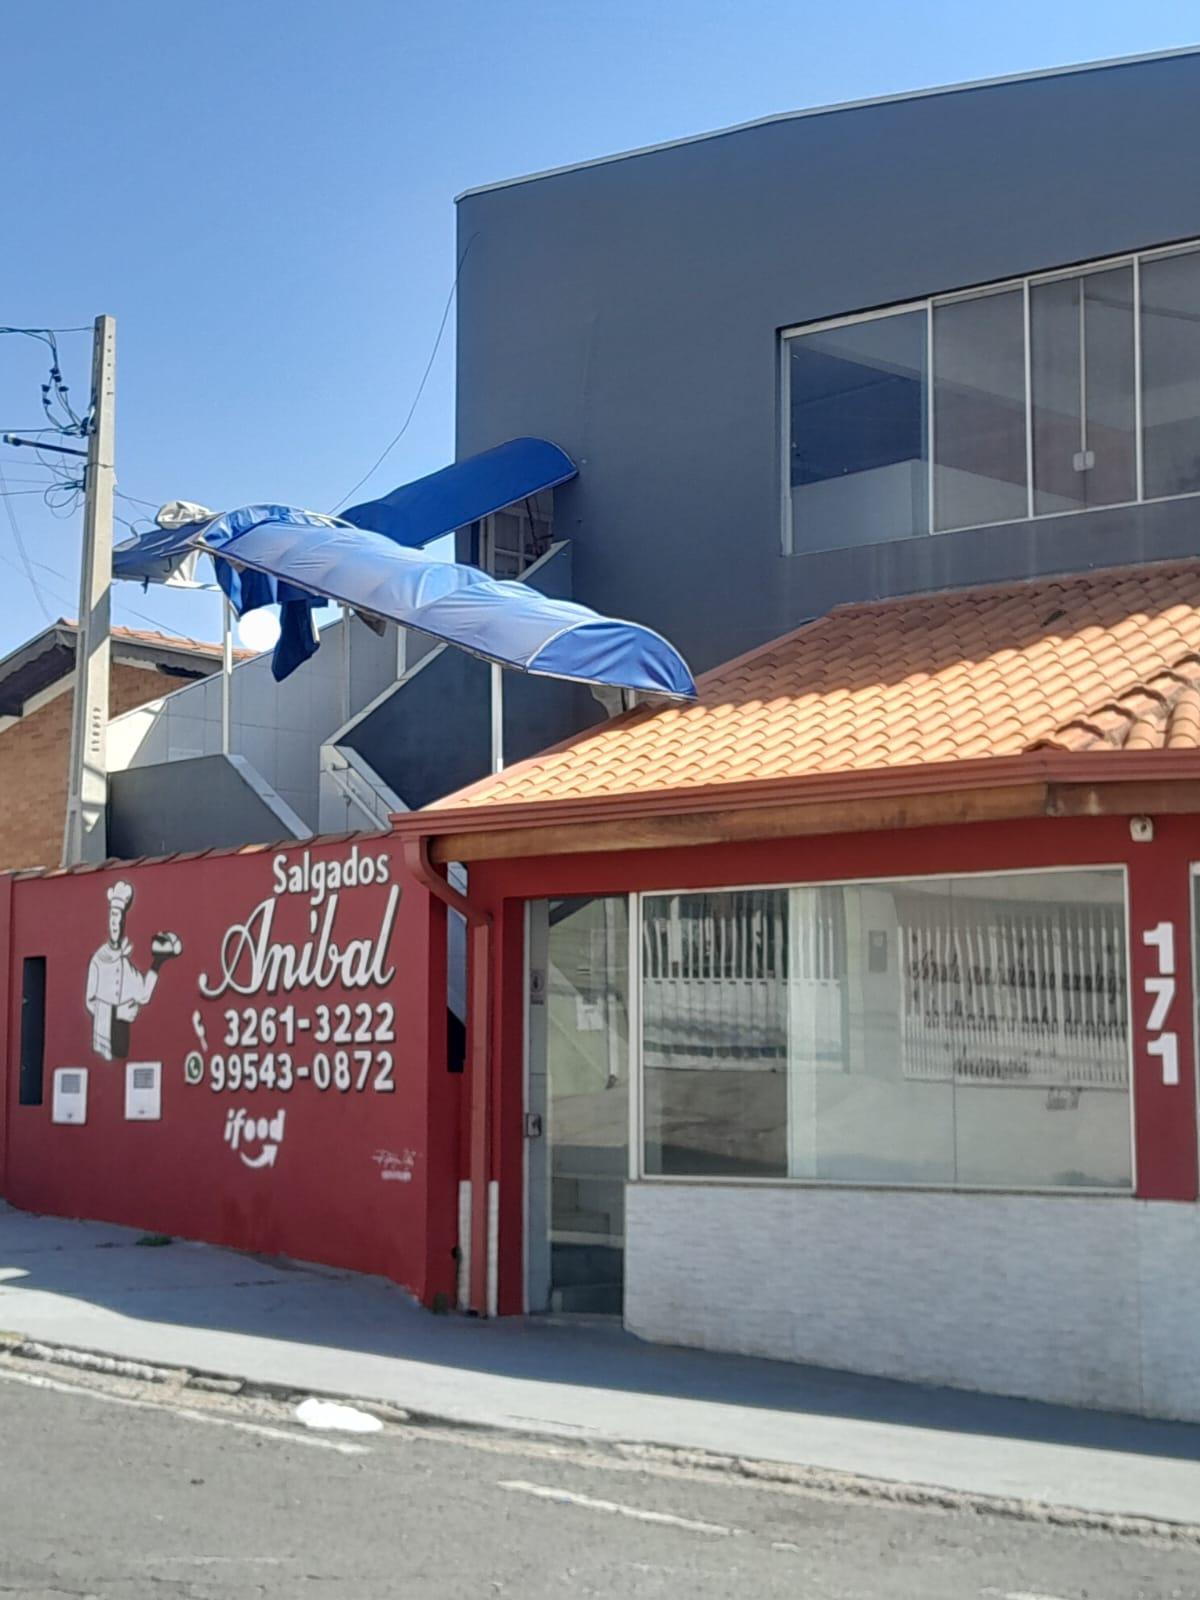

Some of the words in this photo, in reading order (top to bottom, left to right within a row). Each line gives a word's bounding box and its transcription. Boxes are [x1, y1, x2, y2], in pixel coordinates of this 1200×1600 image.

[273, 846, 389, 906] Salgados
[199, 884, 399, 996] Anibal
[224, 1002, 395, 1047] 3261-3222
[210, 1050, 395, 1092] 99543-0872
